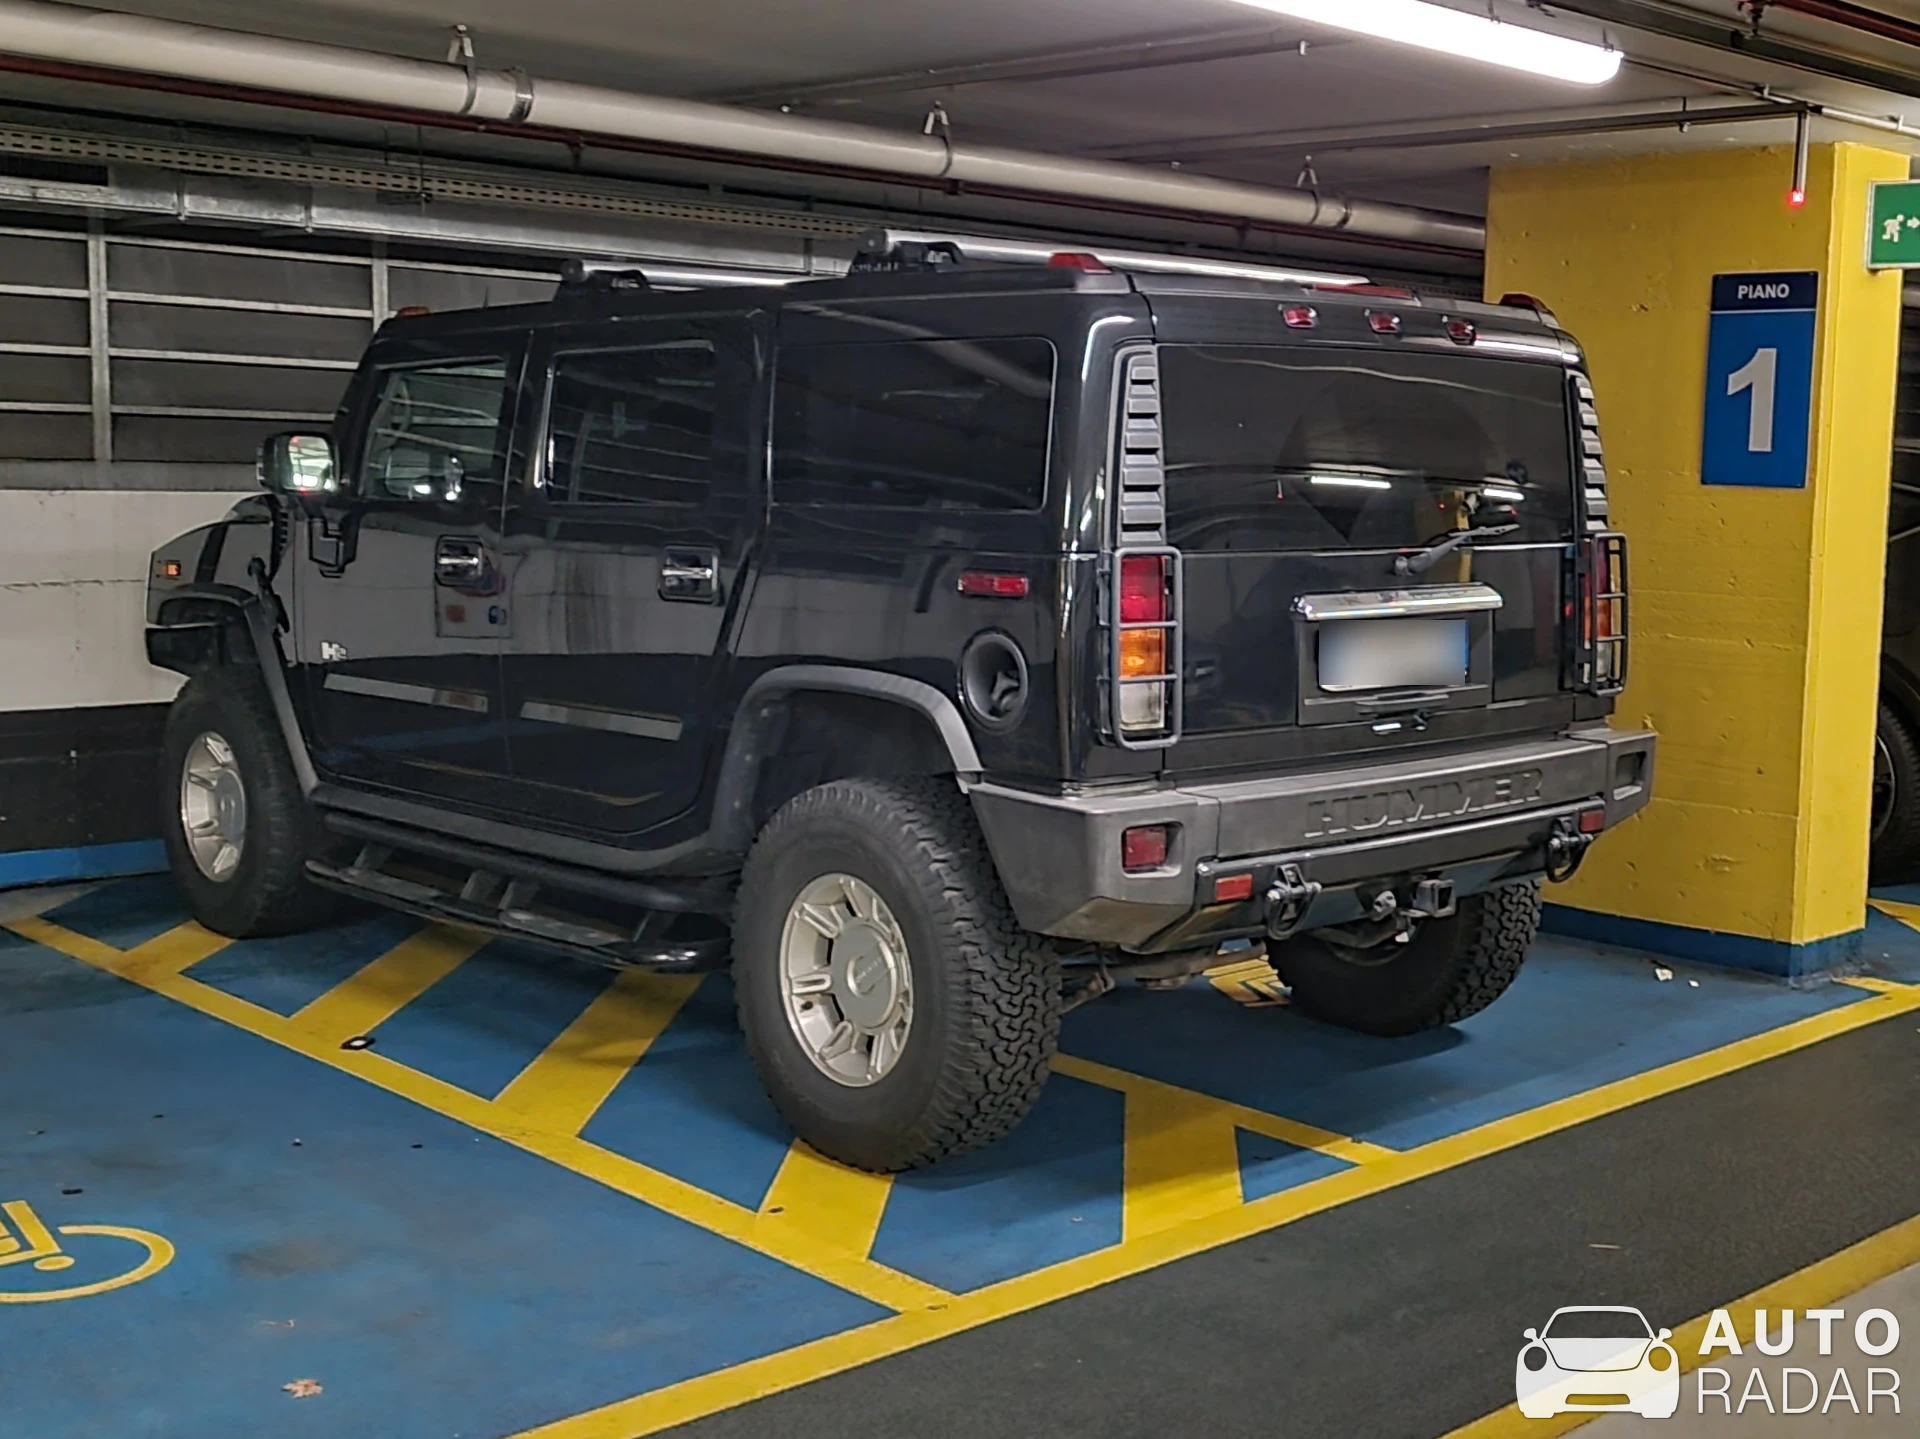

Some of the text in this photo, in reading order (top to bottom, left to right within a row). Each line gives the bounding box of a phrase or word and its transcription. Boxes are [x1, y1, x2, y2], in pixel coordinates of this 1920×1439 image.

[1737, 283, 1790, 299] PIANO
[1727, 348, 1777, 452] 1
[1304, 768, 1542, 838] HUMMER
